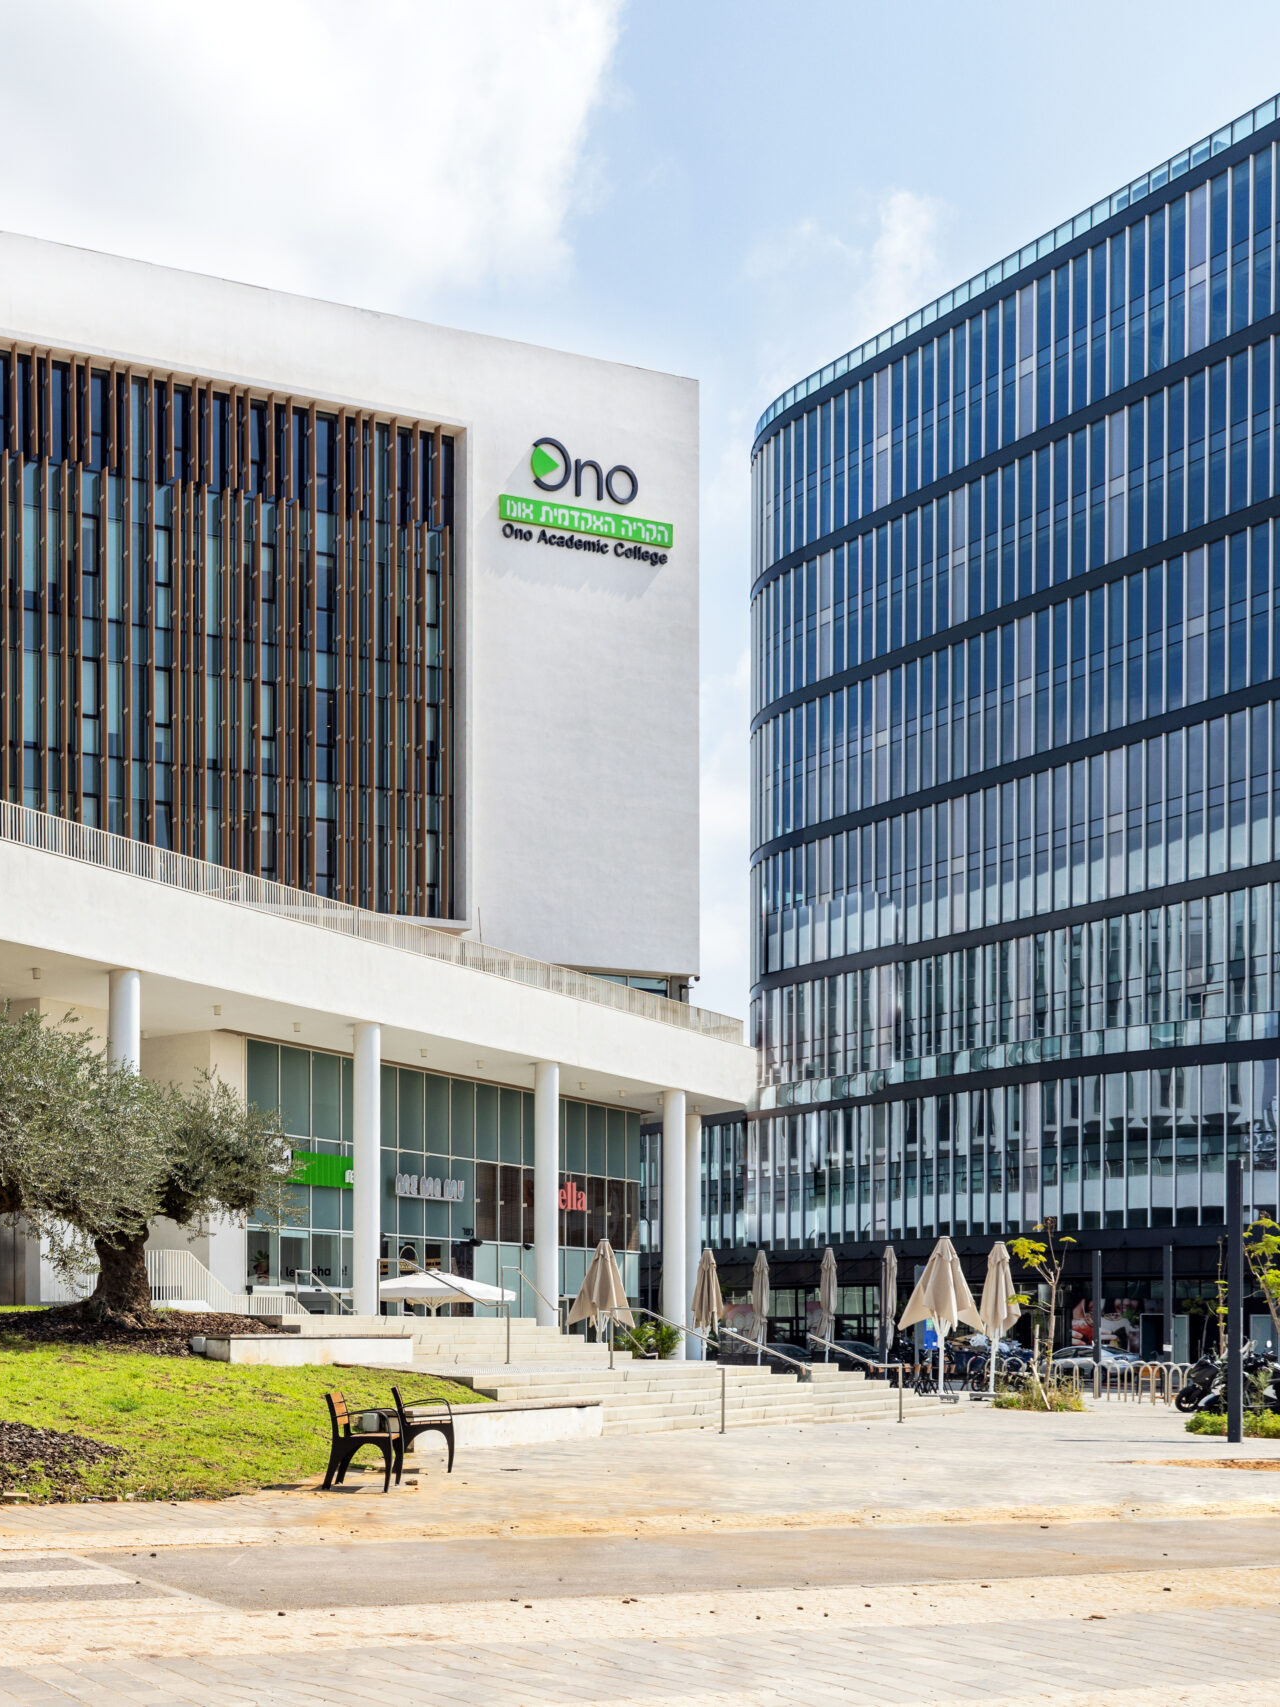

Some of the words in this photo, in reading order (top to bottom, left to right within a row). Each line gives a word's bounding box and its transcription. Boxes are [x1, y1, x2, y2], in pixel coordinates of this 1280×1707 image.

[531, 437, 639, 506] Ono
[506, 500, 534, 521] אונו
[540, 506, 616, 535] האקדמית
[502, 523, 533, 542] Ono
[536, 529, 609, 555] Academic
[614, 543, 668, 567] College
[621, 520, 669, 544] הקריה
[558, 1181, 587, 1211] ella
